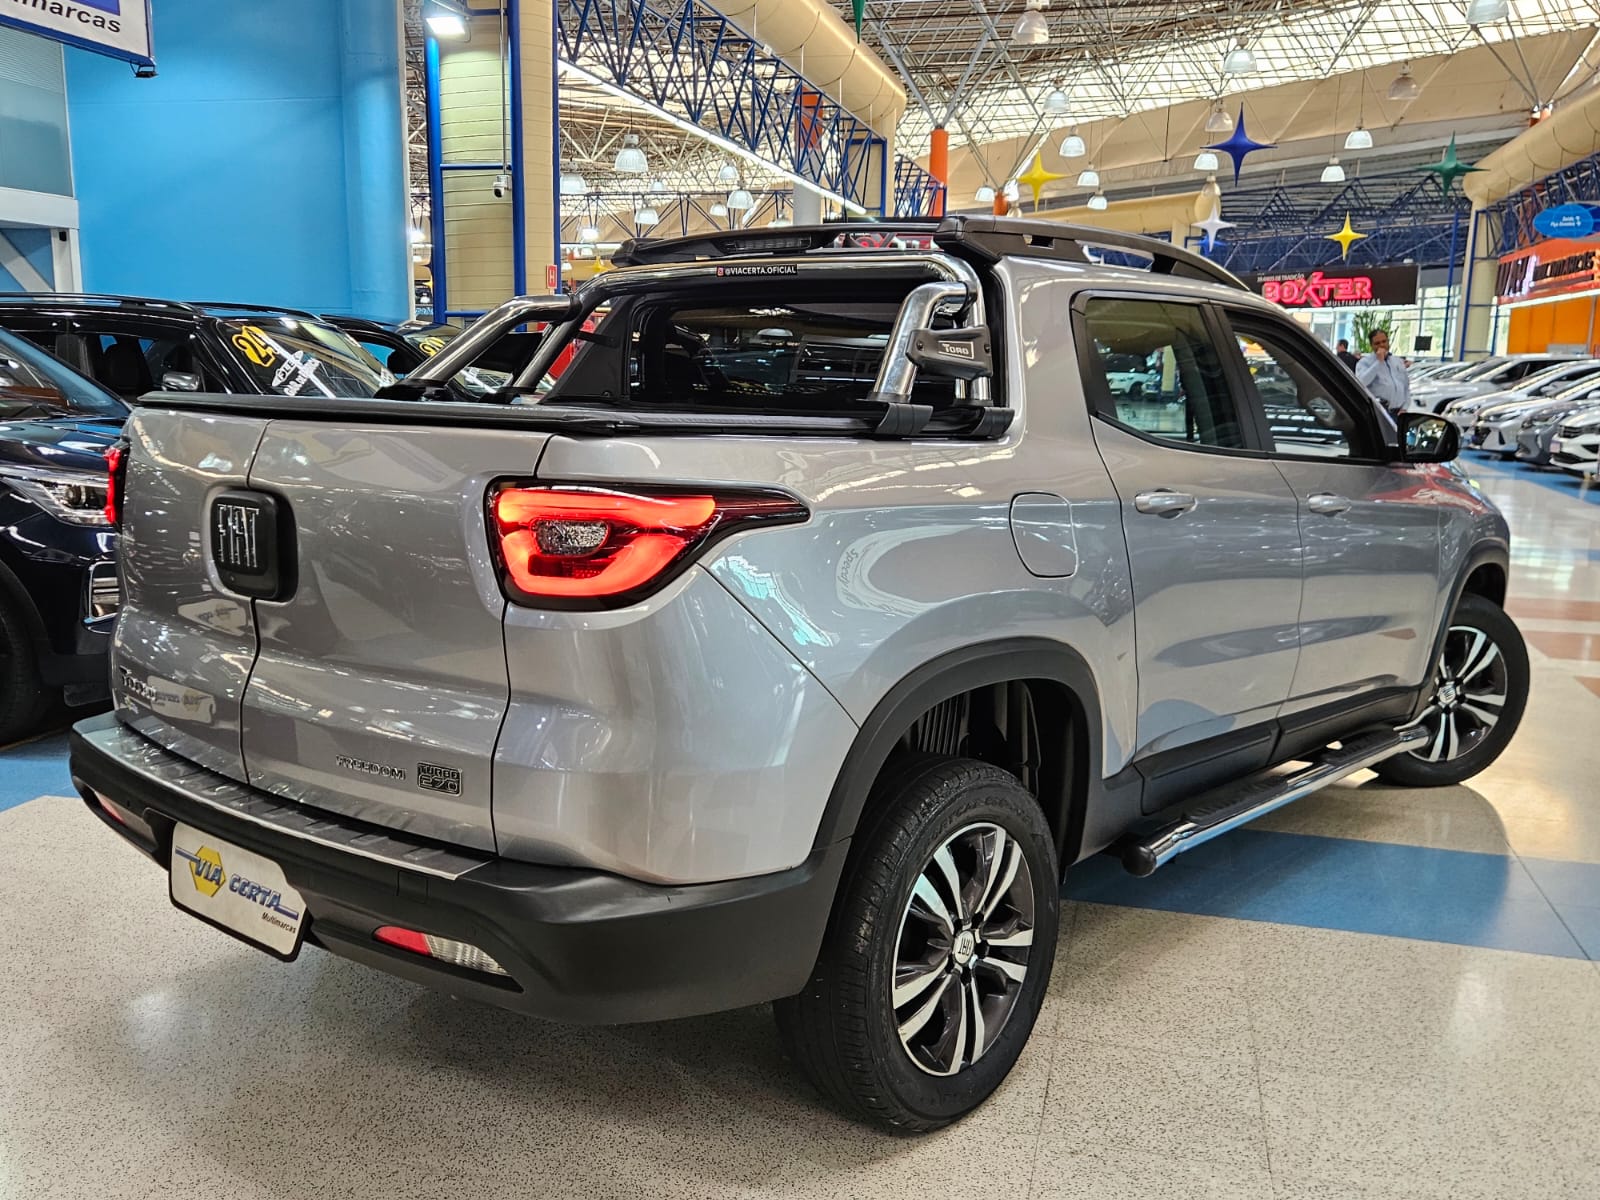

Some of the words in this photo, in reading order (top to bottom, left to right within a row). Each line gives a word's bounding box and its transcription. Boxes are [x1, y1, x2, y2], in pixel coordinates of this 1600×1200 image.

[14, 0, 121, 33] marcas
[725, 265, 796, 276] @VIACERTA.OFICIAL
[1263, 272, 1373, 308] BOXTER
[1325, 298, 1381, 307] MULTIMARCAS
[218, 503, 260, 568] FIAT
[335, 754, 408, 781] FREEDOM
[419, 764, 460, 780] TURBO
[420, 774, 459, 792] 270
[194, 858, 223, 886] VIA
[228, 873, 282, 910] CERTA
[261, 911, 297, 934] Multimarcas
